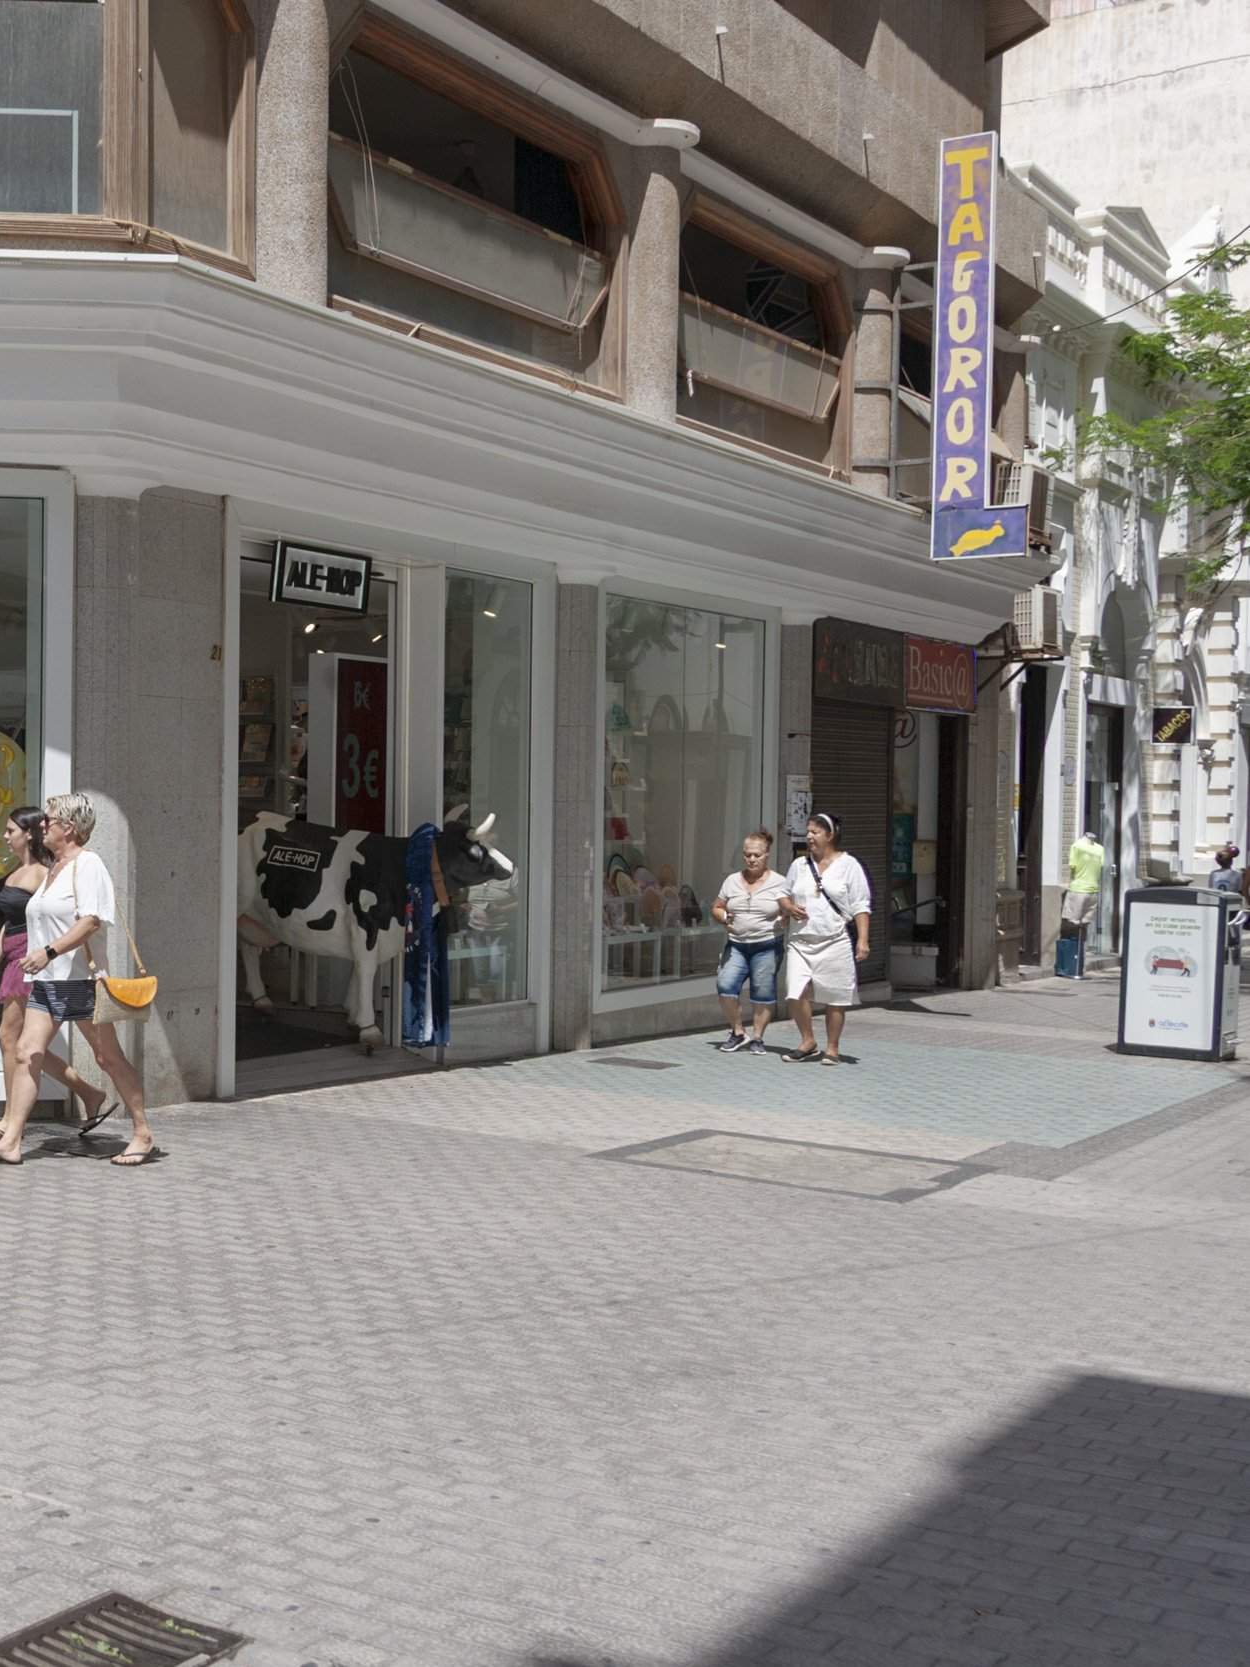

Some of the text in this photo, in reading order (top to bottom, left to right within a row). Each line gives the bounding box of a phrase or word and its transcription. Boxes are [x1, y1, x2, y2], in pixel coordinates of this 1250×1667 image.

[939, 147, 990, 502] TAGOROR
[285, 560, 363, 597] ALE-HOP
[1155, 709, 1191, 742] TABACOS
[341, 733, 379, 799] 3€
[272, 850, 316, 866] ALE-HOP
